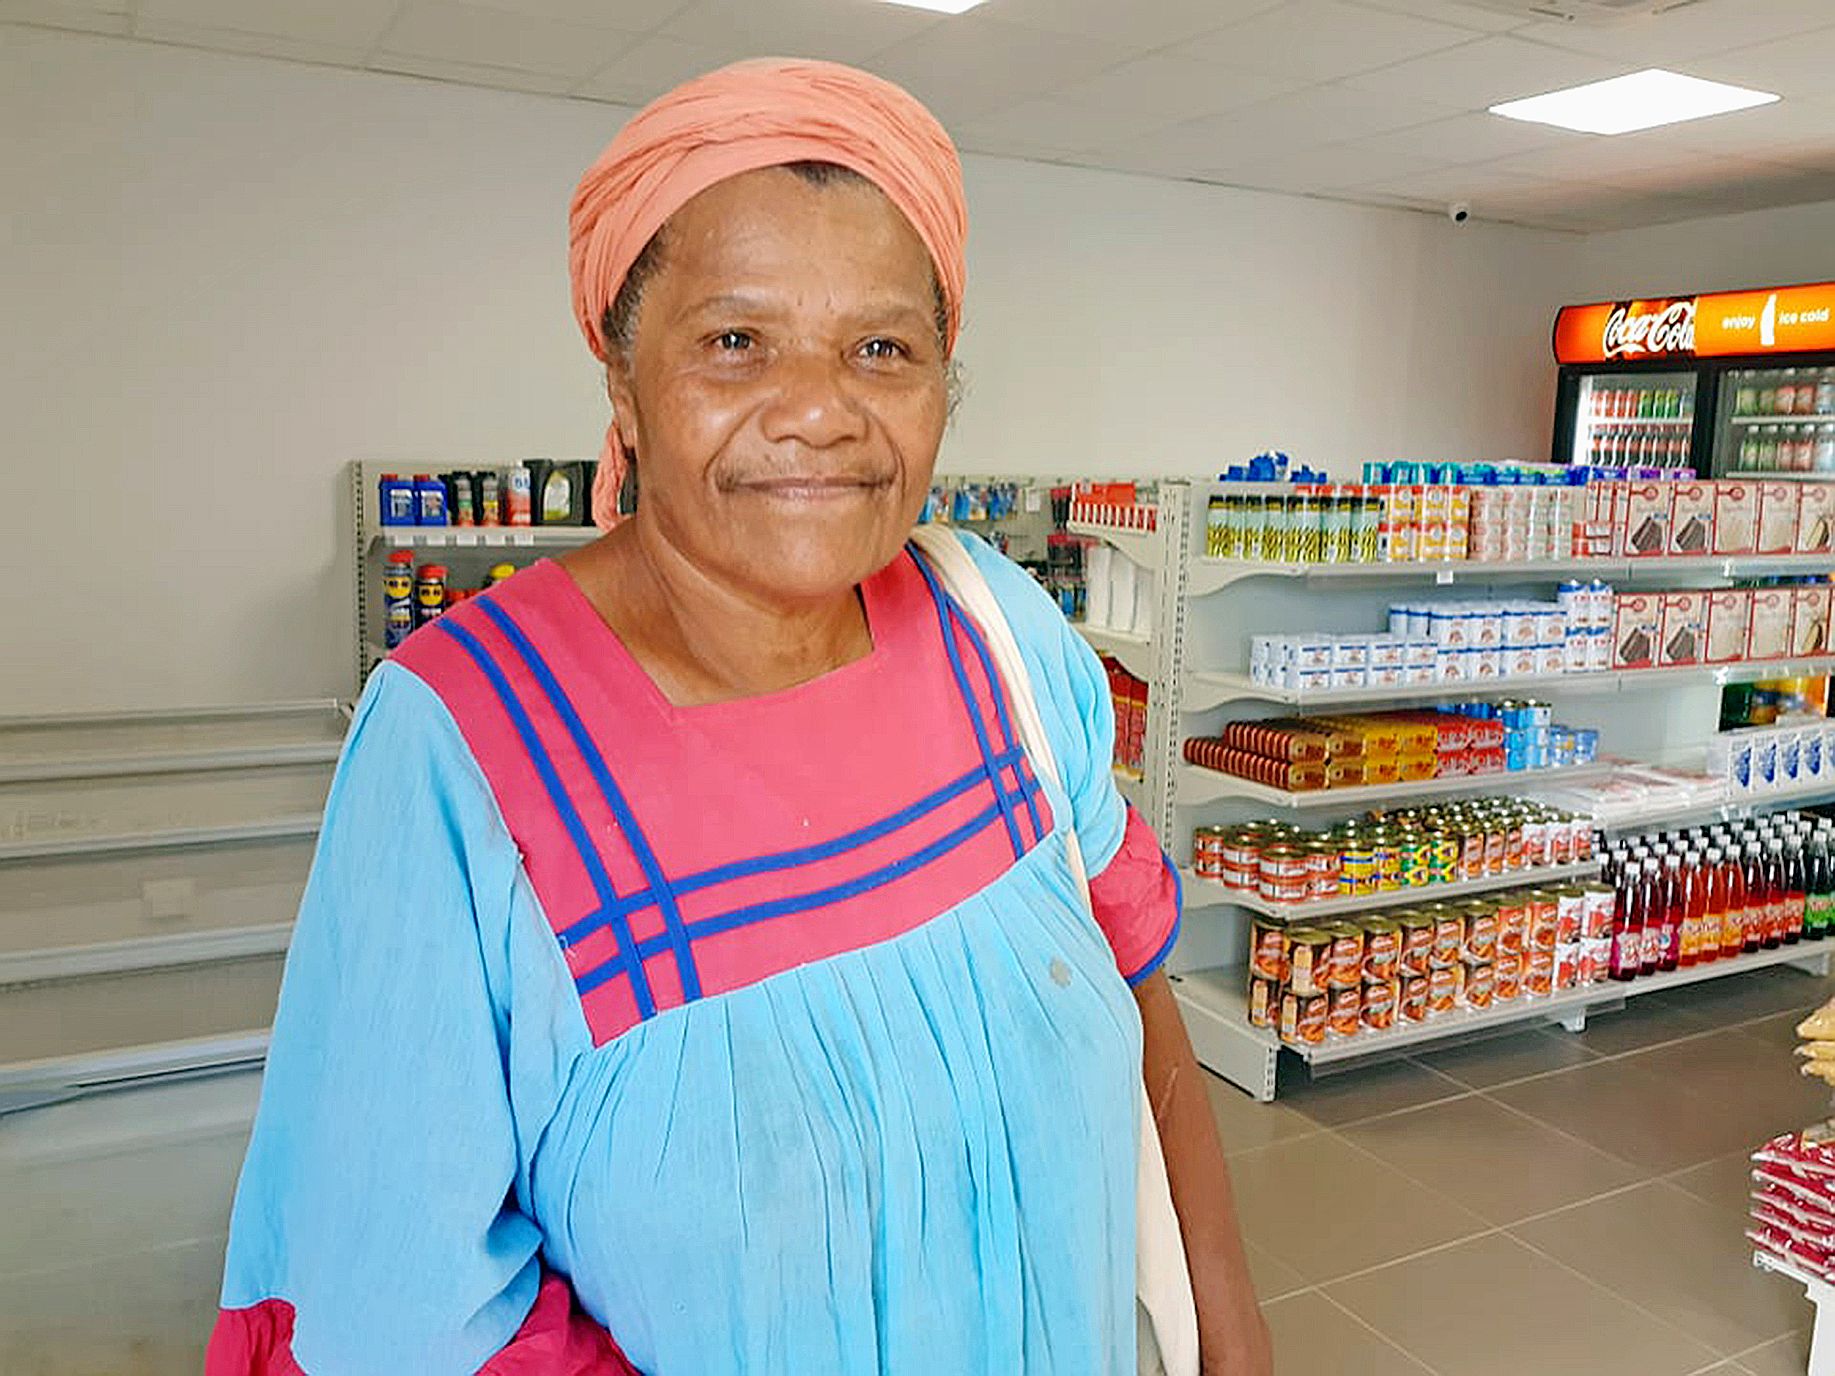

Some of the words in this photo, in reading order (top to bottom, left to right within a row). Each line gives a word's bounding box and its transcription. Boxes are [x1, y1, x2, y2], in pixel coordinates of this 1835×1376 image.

[1722, 313, 1756, 330] enjoy
[1778, 309, 1798, 325] ice
[1800, 307, 1830, 323] cold
